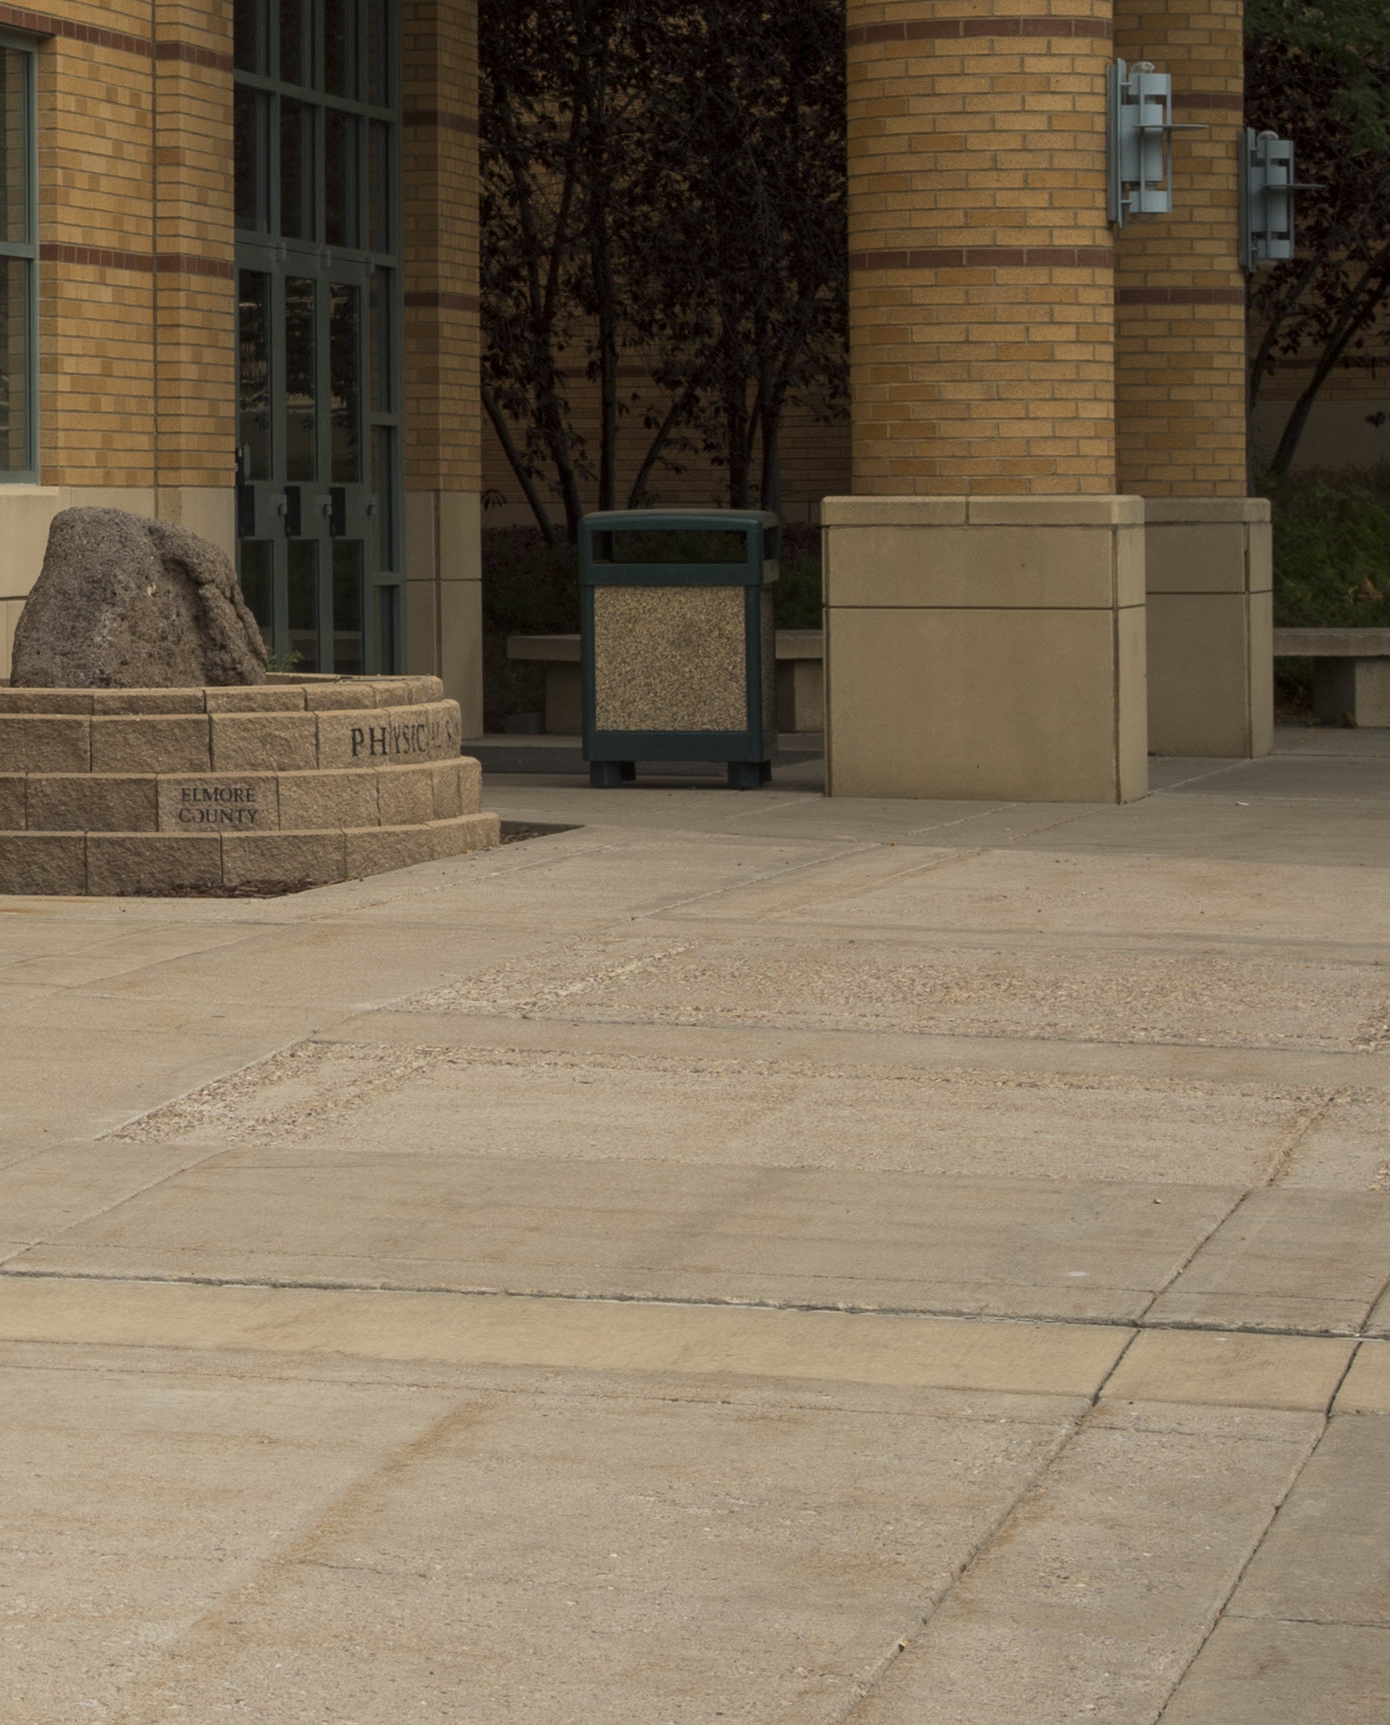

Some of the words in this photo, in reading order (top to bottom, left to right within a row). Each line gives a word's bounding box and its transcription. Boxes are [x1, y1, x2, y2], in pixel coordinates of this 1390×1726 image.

[350, 720, 440, 757] PHYSIC
[181, 787, 256, 802] ELMORE
[179, 808, 258, 824] COUNTY
